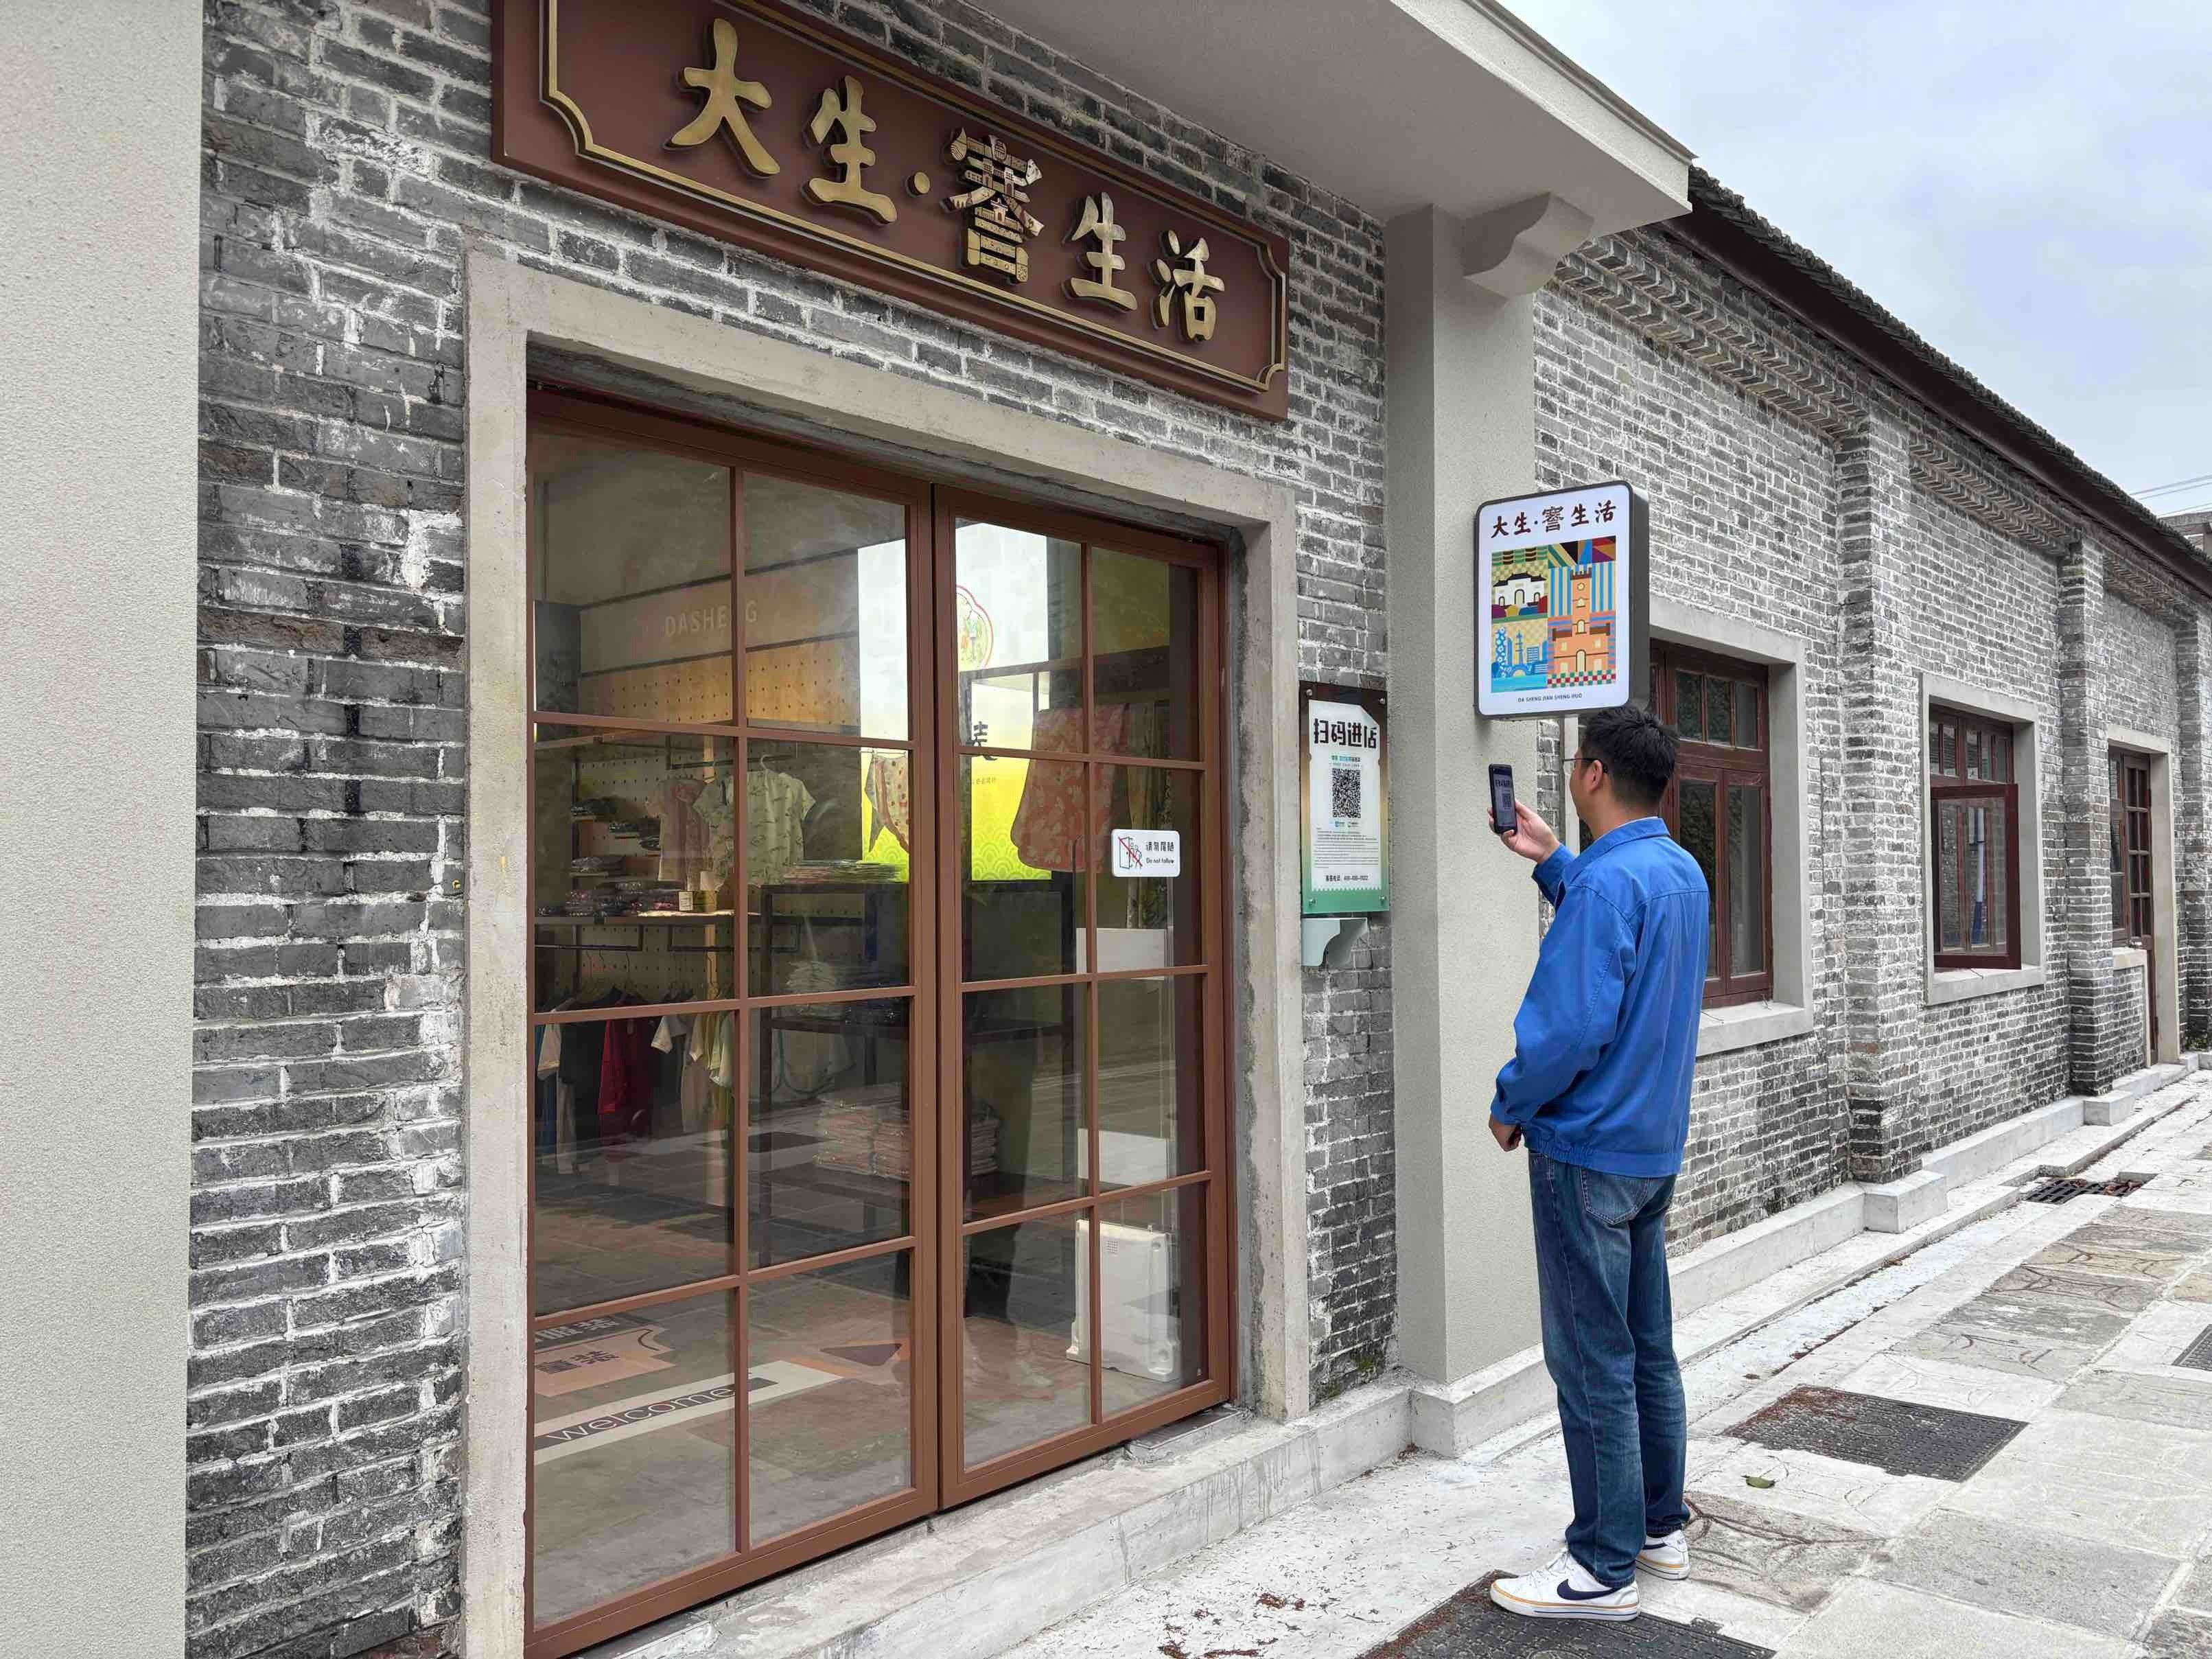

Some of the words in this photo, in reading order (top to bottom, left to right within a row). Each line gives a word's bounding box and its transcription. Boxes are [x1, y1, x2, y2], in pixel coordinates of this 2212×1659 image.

[664, 599, 758, 638] DASHEG
[1314, 718, 1377, 749] 扫码进店
[1145, 841, 1174, 852] 请勿尾随
[533, 1318, 620, 1344] 服装
[546, 1387, 736, 1441] welcome
